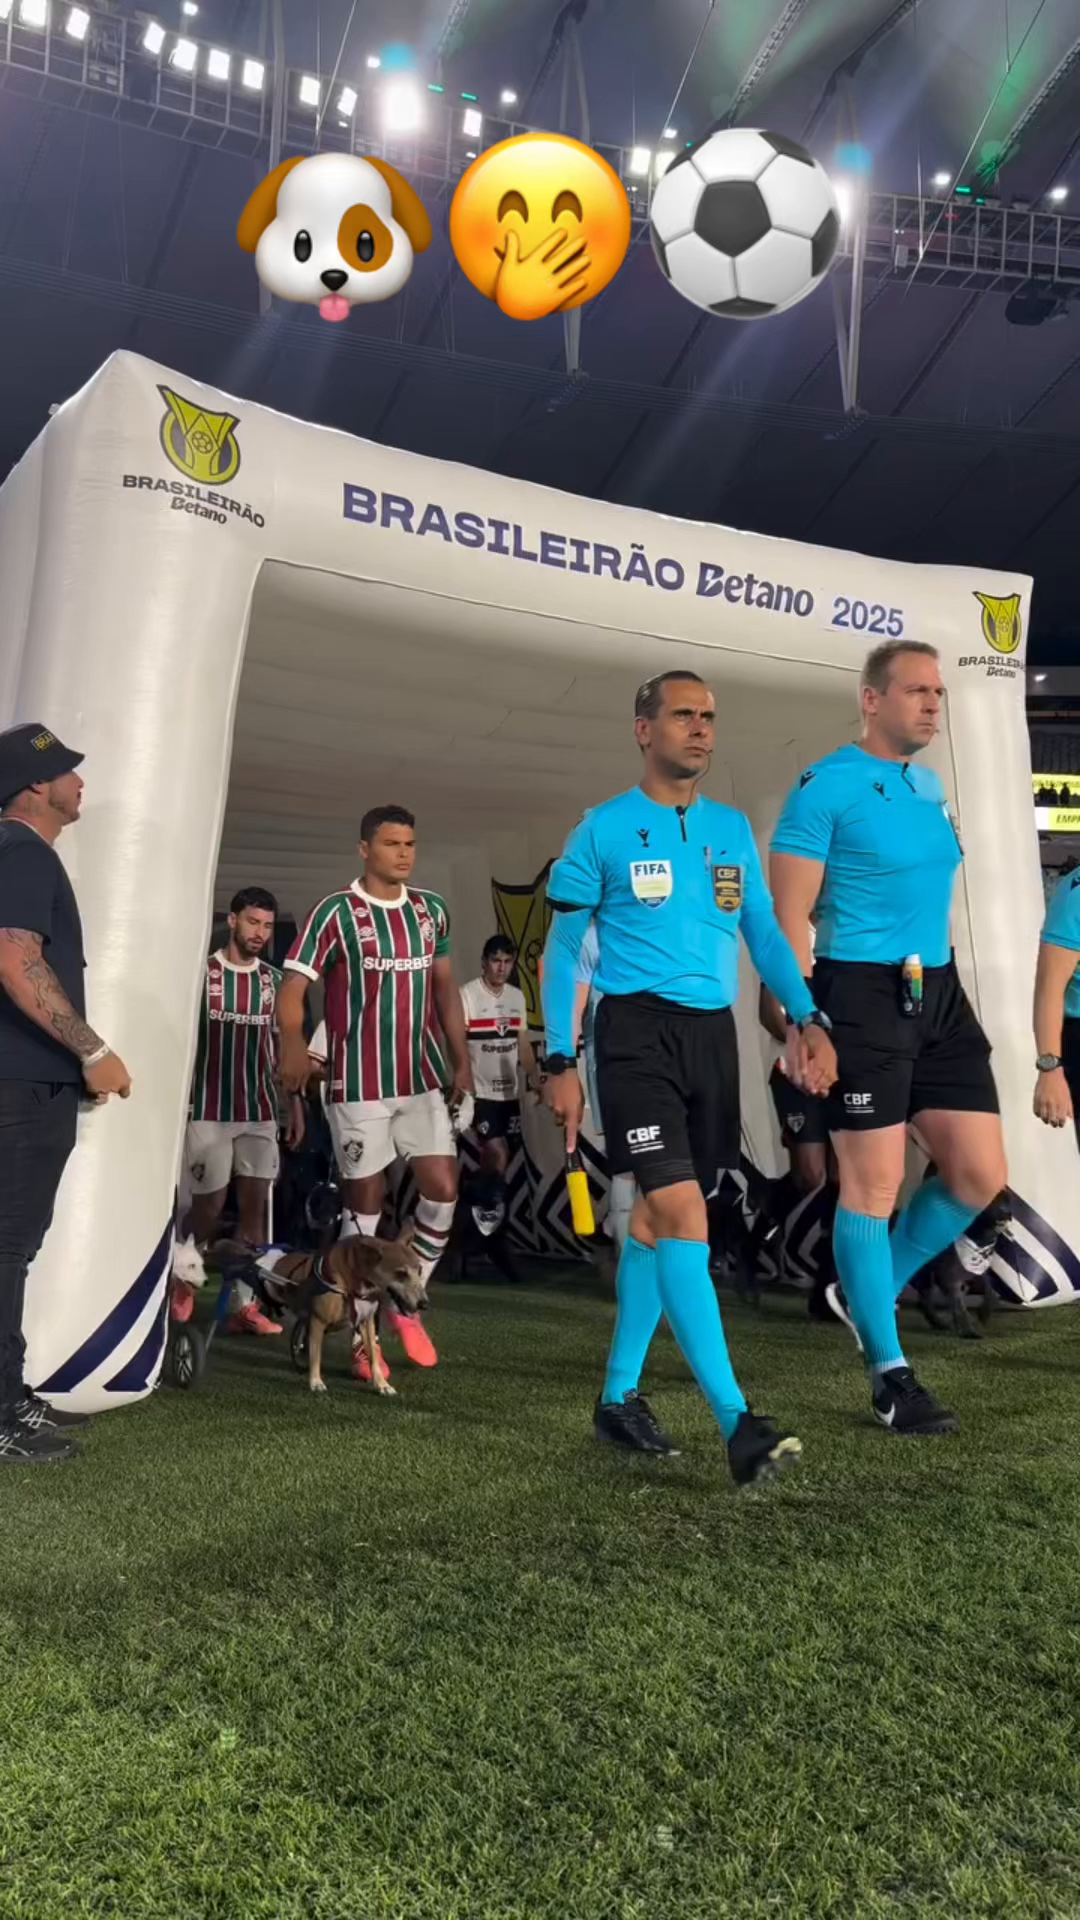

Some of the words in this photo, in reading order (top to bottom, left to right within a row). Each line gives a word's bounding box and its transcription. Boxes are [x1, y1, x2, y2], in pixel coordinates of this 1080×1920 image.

[122, 474, 265, 528] BRASILEIRÃO
[170, 496, 228, 525] Betano
[343, 482, 685, 591] BRASILEIRÃO
[696, 561, 814, 617] Betano
[831, 597, 904, 637] 2025
[633, 863, 668, 877] FIFA
[717, 868, 738, 879] CBF
[209, 1009, 272, 1025] SUPERBET
[843, 1092, 873, 1105] CBF
[626, 1125, 661, 1144] CBF
